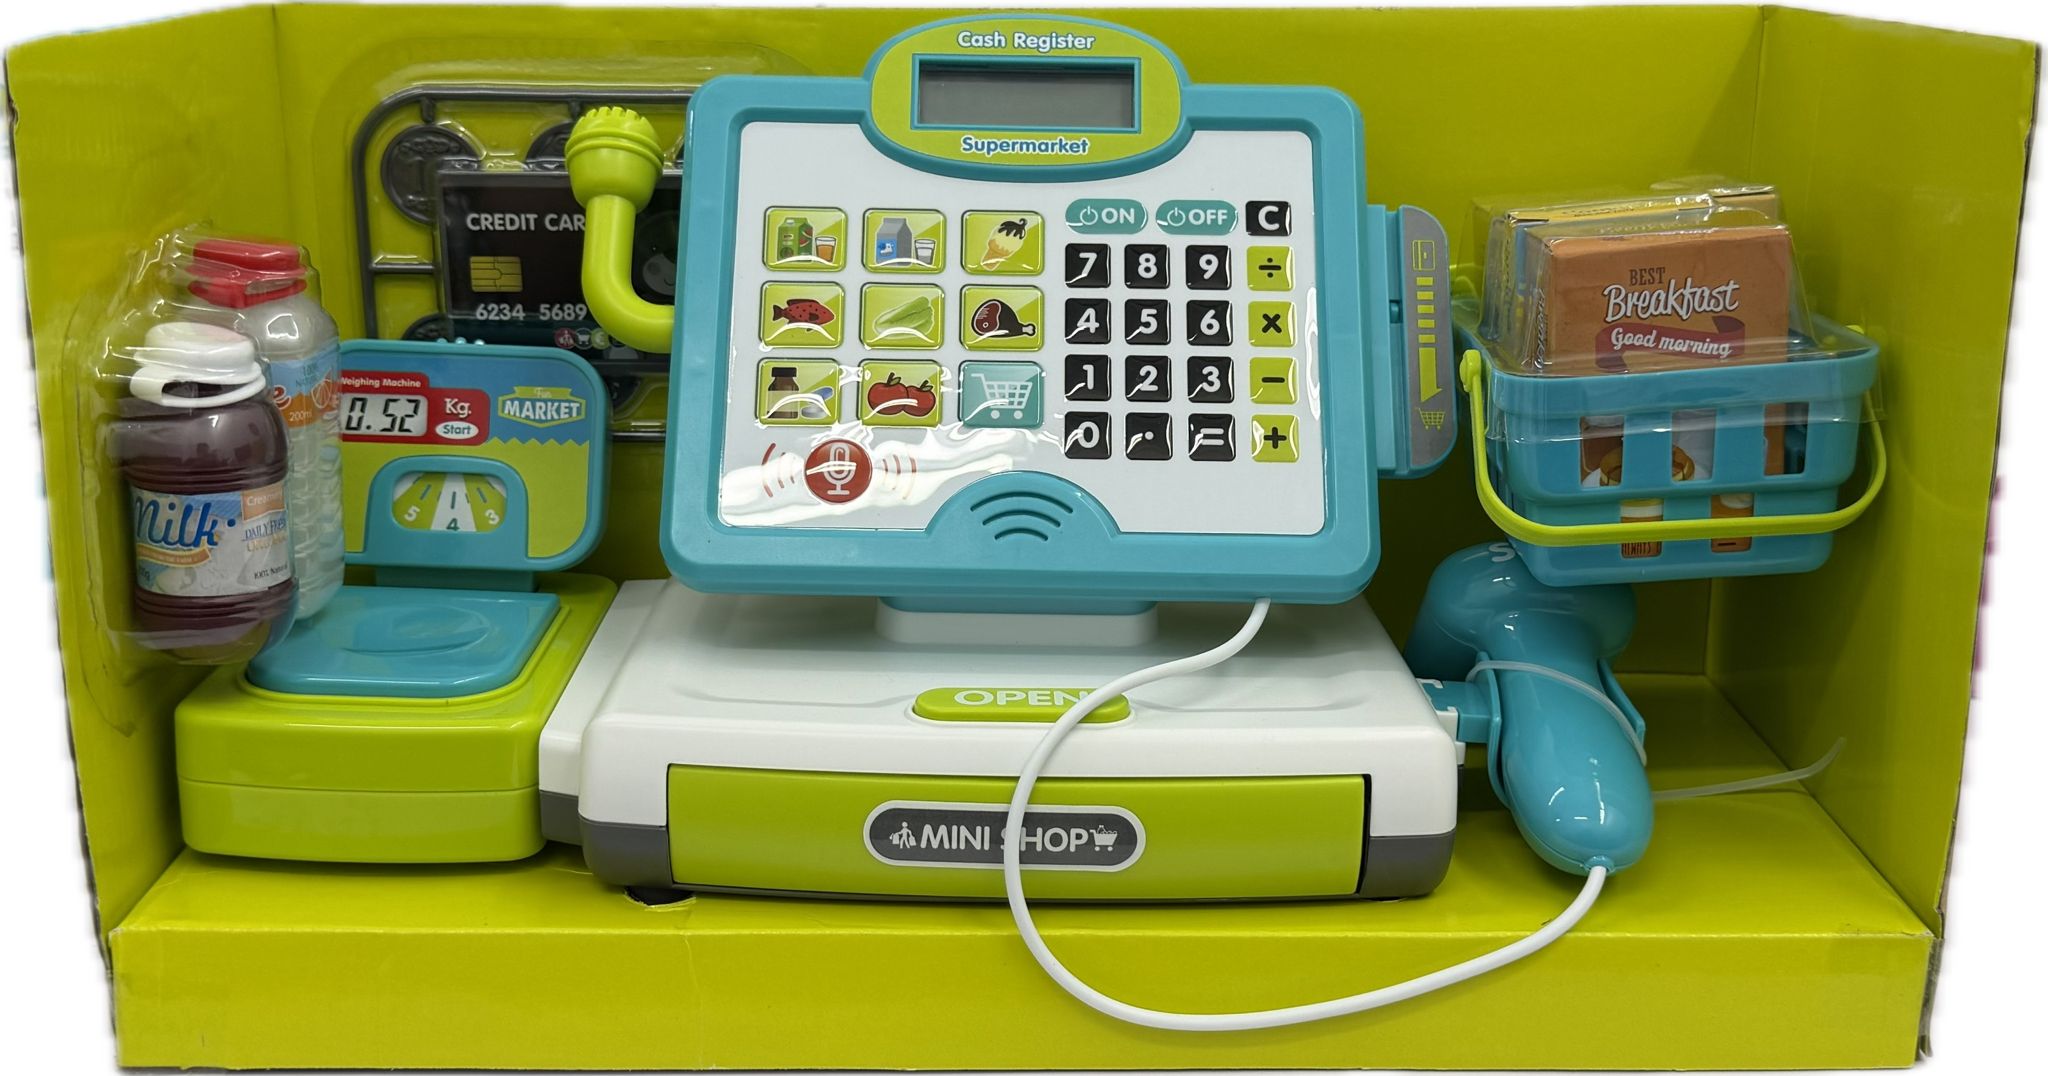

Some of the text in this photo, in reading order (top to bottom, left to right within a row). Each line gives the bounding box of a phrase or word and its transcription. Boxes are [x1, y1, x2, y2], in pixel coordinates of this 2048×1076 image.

[958, 31, 1096, 53] Cash Register
[961, 134, 1090, 157] Supermarket
[466, 213, 586, 231] CREDIT CAR
[1101, 207, 1135, 224] ON
[1188, 209, 1228, 226] OFF
[1258, 205, 1280, 231] C
[1079, 252, 1098, 278] 7
[1138, 252, 1158, 279] 8
[1199, 253, 1219, 280] 9
[1629, 267, 1666, 286] BEST
[1602, 277, 1740, 322] Breakfast
[476, 303, 588, 321] 6234 5689
[1077, 307, 1100, 334] 4
[1139, 308, 1158, 334] 5
[1200, 309, 1220, 336] 6
[1610, 327, 1732, 359] Good morning
[382, 378, 421, 388] Machine
[1082, 364, 1095, 390] 1
[1139, 365, 1159, 392] 2
[1202, 365, 1221, 393] 3
[345, 397, 421, 433] 0.52
[444, 398, 472, 418] Kg.
[504, 400, 581, 420] MARKET
[442, 424, 471, 435] Start
[1077, 421, 1100, 448] 0
[403, 505, 500, 532] 5 4 3
[954, 690, 1087, 706] OPEN
[920, 823, 1089, 852] MINI HOP
